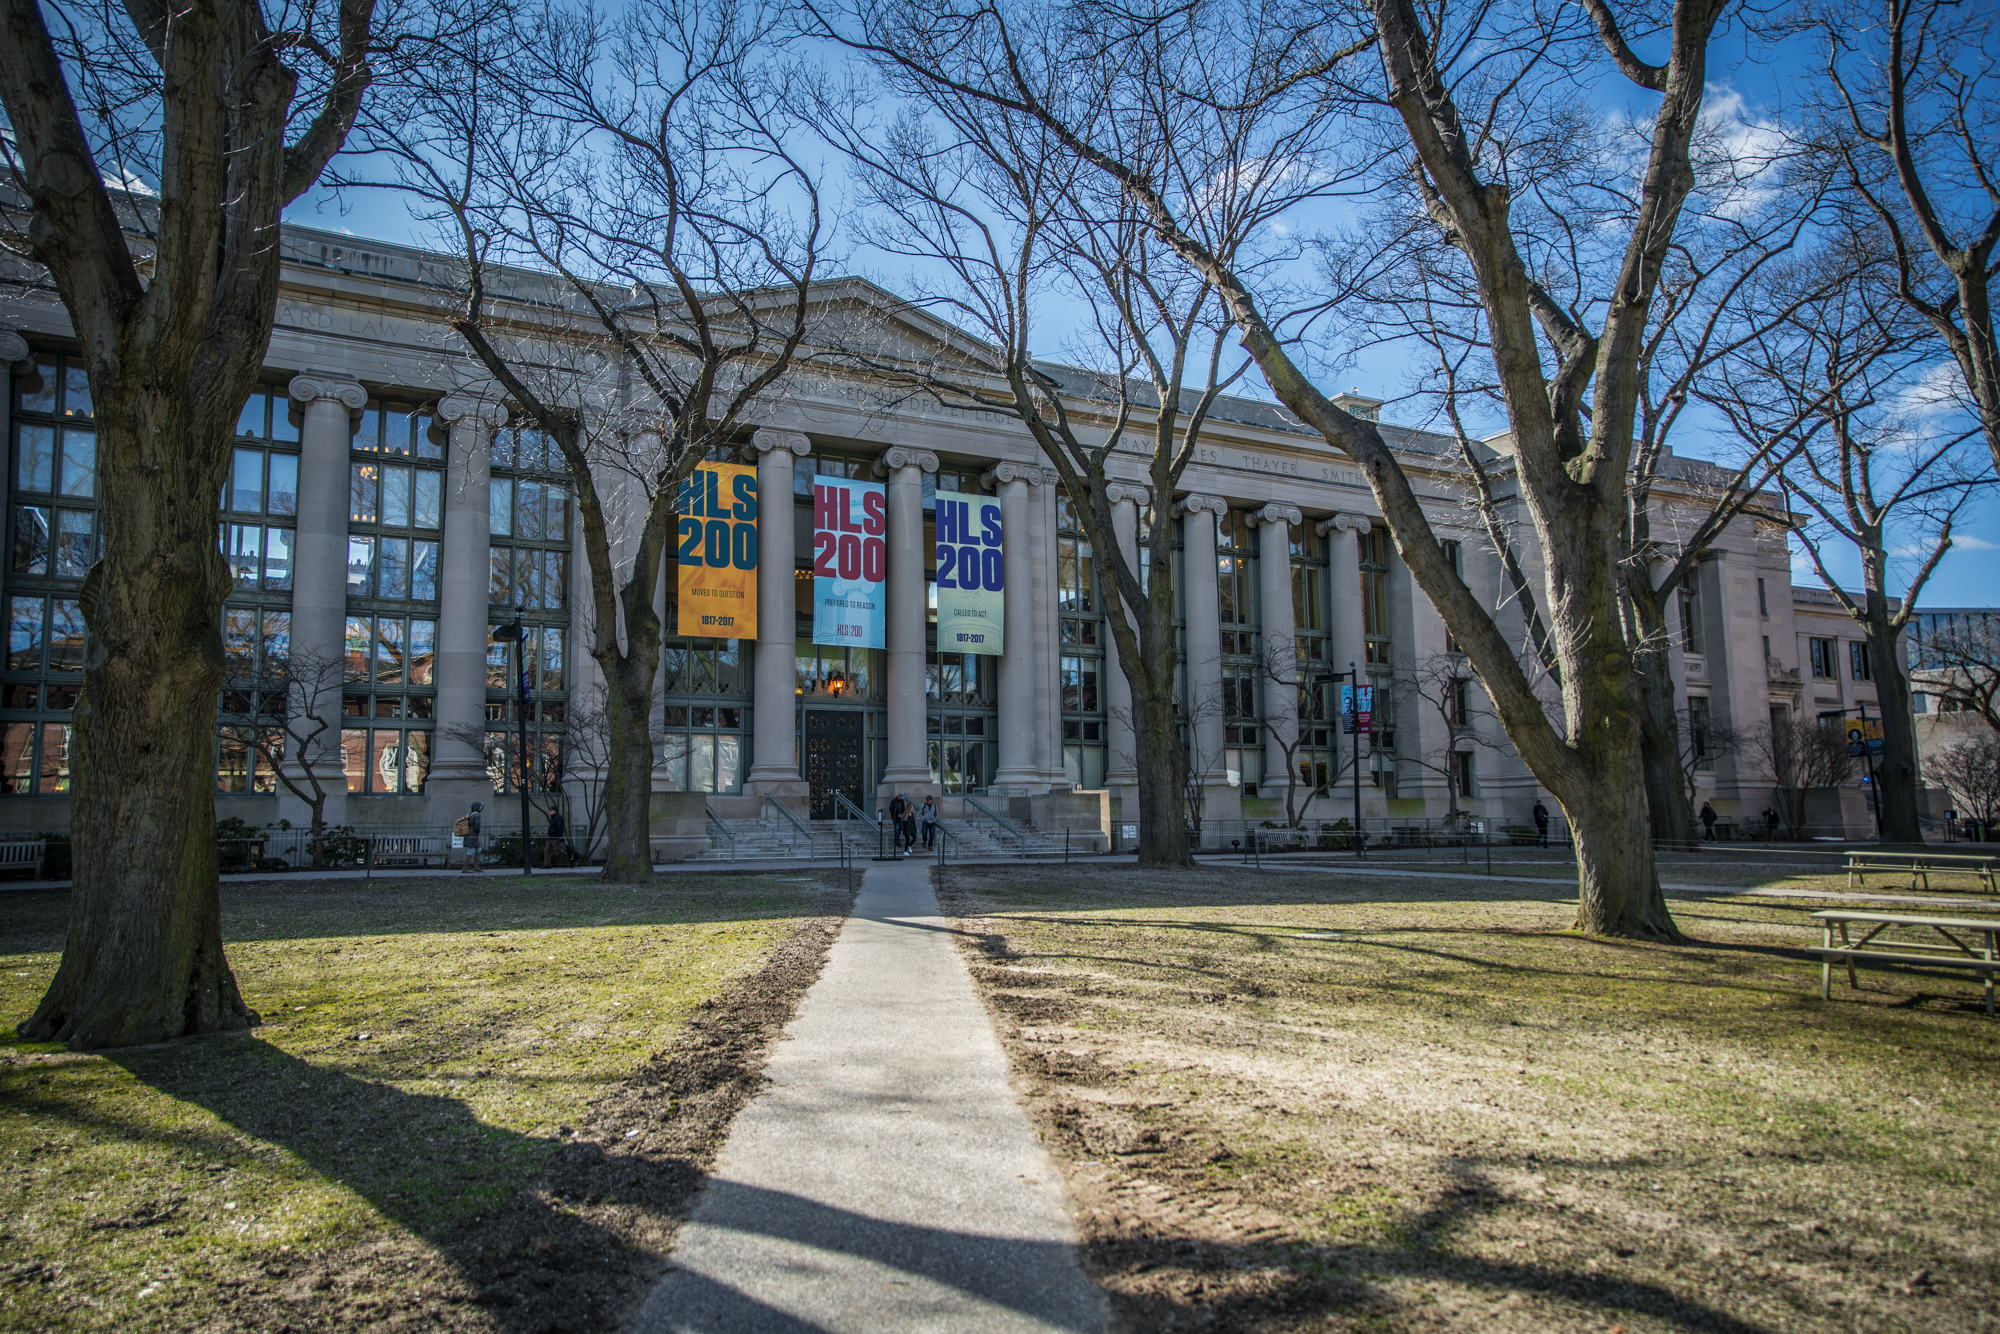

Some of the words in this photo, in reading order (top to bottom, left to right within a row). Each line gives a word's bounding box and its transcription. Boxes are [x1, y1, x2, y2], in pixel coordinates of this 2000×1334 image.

[278, 306, 333, 329] ARD
[350, 317, 401, 339] LAW
[1121, 437, 1151, 453] RAY
[1242, 455, 1298, 475] THAYER
[1322, 468, 1363, 485] SMITH
[679, 469, 757, 522] HLS
[814, 484, 885, 537] HLS
[936, 498, 1002, 548] HLS
[678, 517, 757, 571] 200
[814, 531, 886, 583] 200
[936, 544, 1004, 592] 200
[691, 588, 710, 597] MOVED
[712, 589, 718, 598] TO
[719, 590, 745, 599] QUESTION
[825, 598, 848, 608] PREPARED
[850, 600, 856, 609] TO
[857, 601, 876, 610] REASON
[701, 615, 735, 627] 1817-2017
[954, 609, 970, 617] CALLED
[972, 609, 978, 618] TO
[978, 610, 987, 618] ACT
[956, 633, 985, 644] 1817-2017
[1357, 687, 1372, 700] HLS
[1357, 700, 1371, 712] 200
